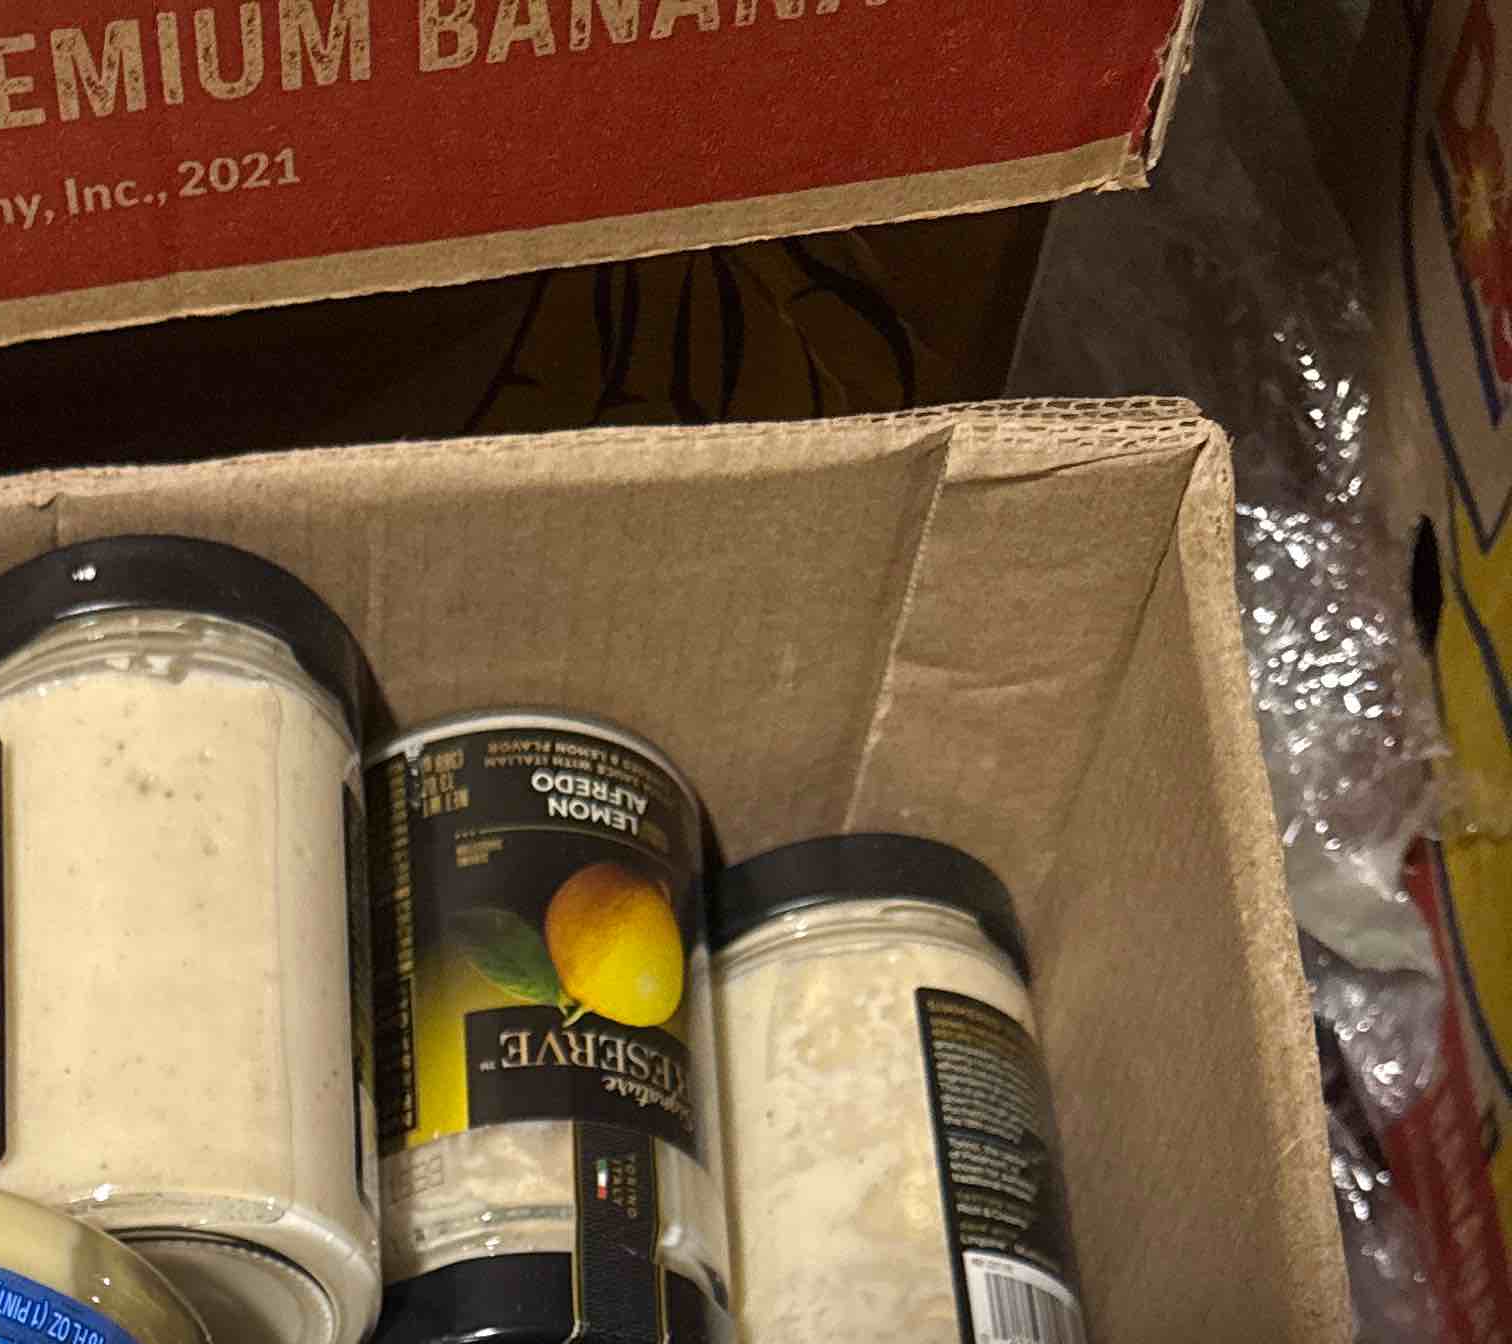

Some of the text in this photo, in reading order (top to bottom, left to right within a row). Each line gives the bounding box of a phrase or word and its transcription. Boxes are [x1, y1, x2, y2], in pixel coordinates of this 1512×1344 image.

[64, 178, 166, 215] Inc.,
[177, 147, 300, 196] 2021
[531, 770, 648, 815] ALFREDO
[547, 797, 636, 834] LEMON
[499, 1028, 691, 1088] RESERVE
